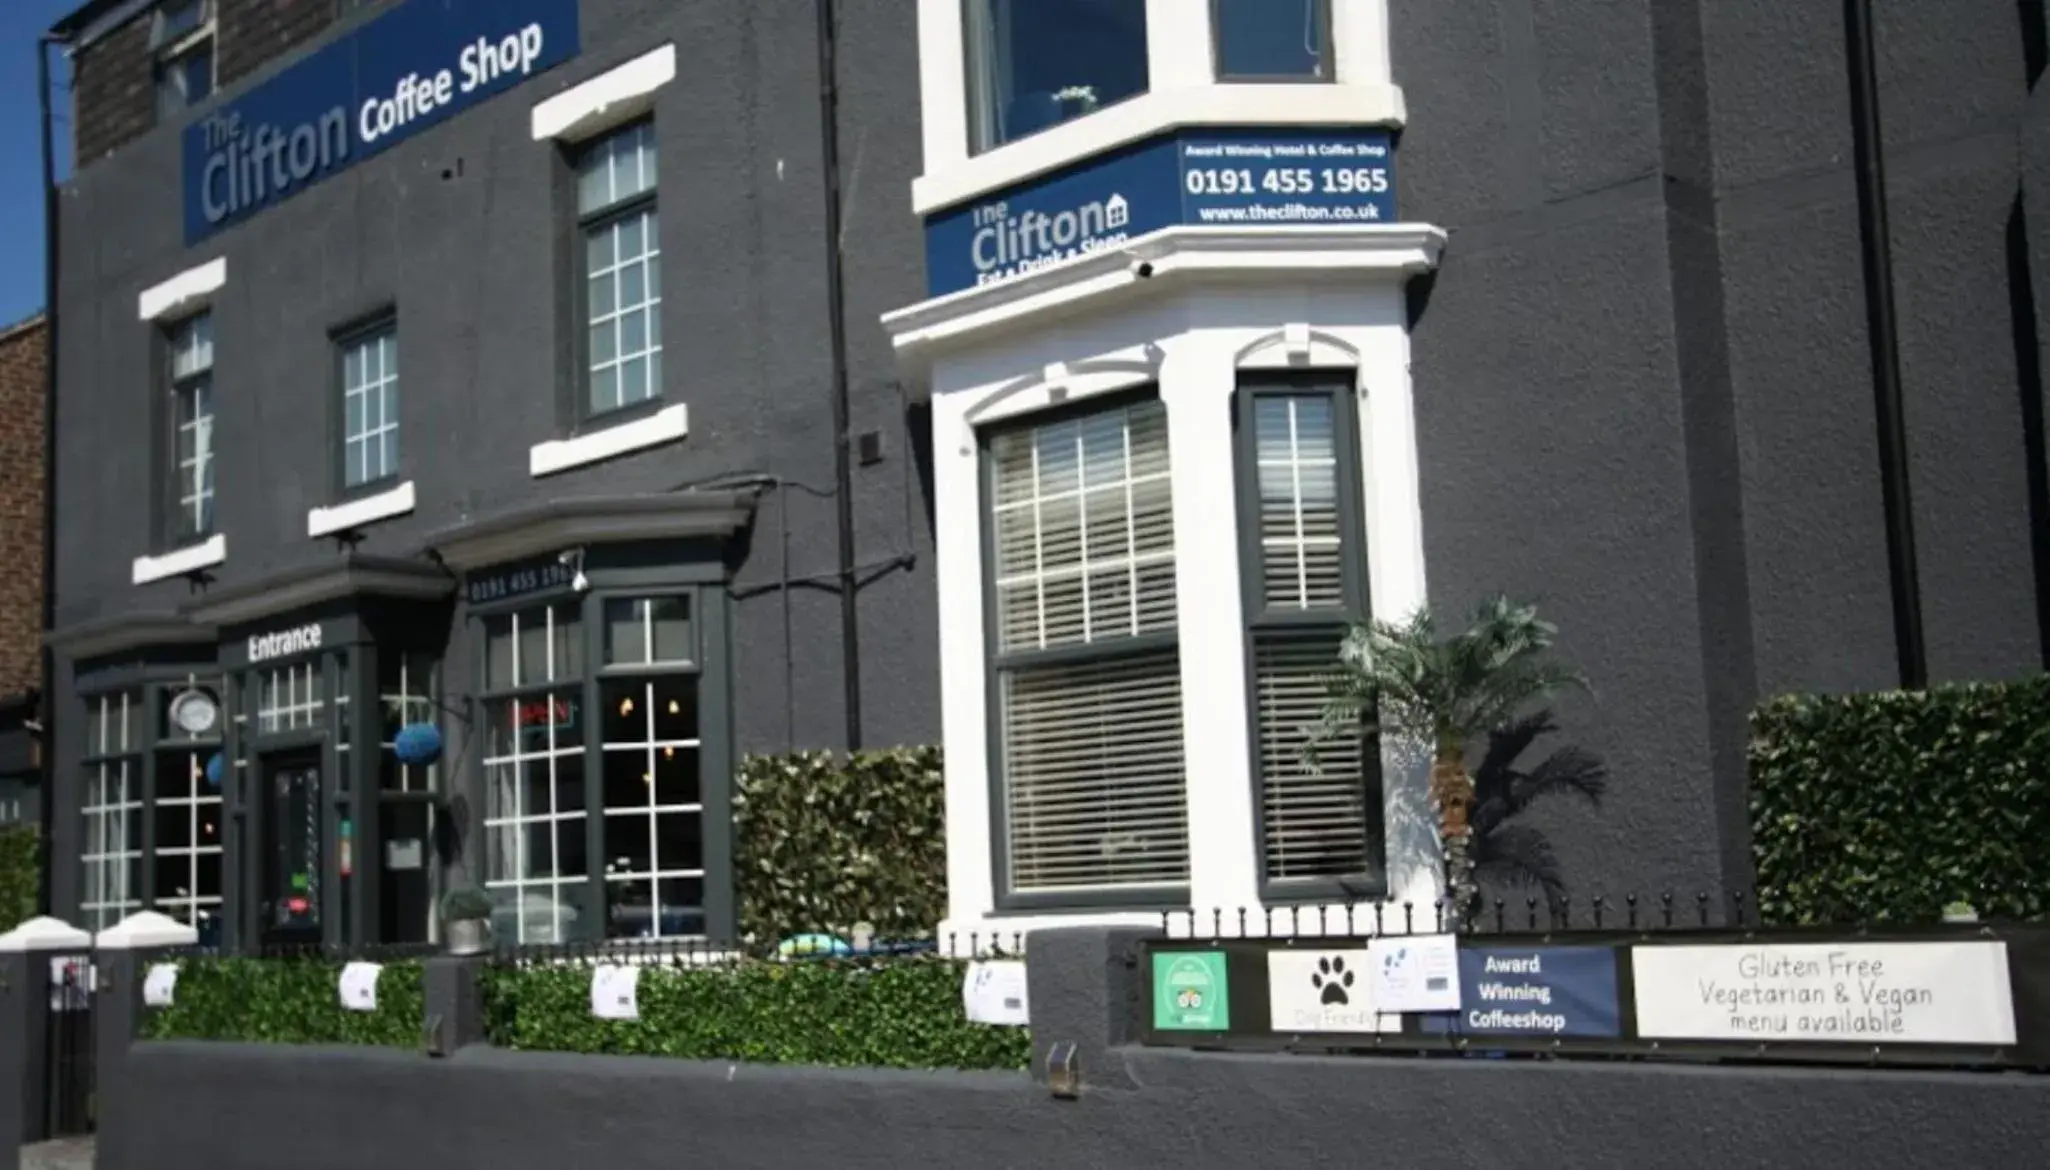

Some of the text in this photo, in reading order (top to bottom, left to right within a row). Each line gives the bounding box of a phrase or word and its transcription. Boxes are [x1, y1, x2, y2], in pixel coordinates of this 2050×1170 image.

[202, 22, 544, 223] Clifton Coffee Shop
[202, 110, 242, 150] The
[1185, 144, 1386, 158] Award Winning Hotel & Coffee Shop
[1186, 168, 1389, 194] 0191 455 1965
[1199, 203, 1379, 221] www.theclifton.co.uk
[972, 201, 1104, 271] Clifton
[248, 623, 322, 663] Entrance
[1485, 954, 1542, 973] Award
[1738, 952, 1886, 979] Gluten Free
[1477, 982, 1552, 1005] Winning
[1698, 977, 1934, 1014] Vegetarian & Vegan
[1469, 1009, 1567, 1032] Coffeeshop
[1730, 1009, 1906, 1034] menu available
